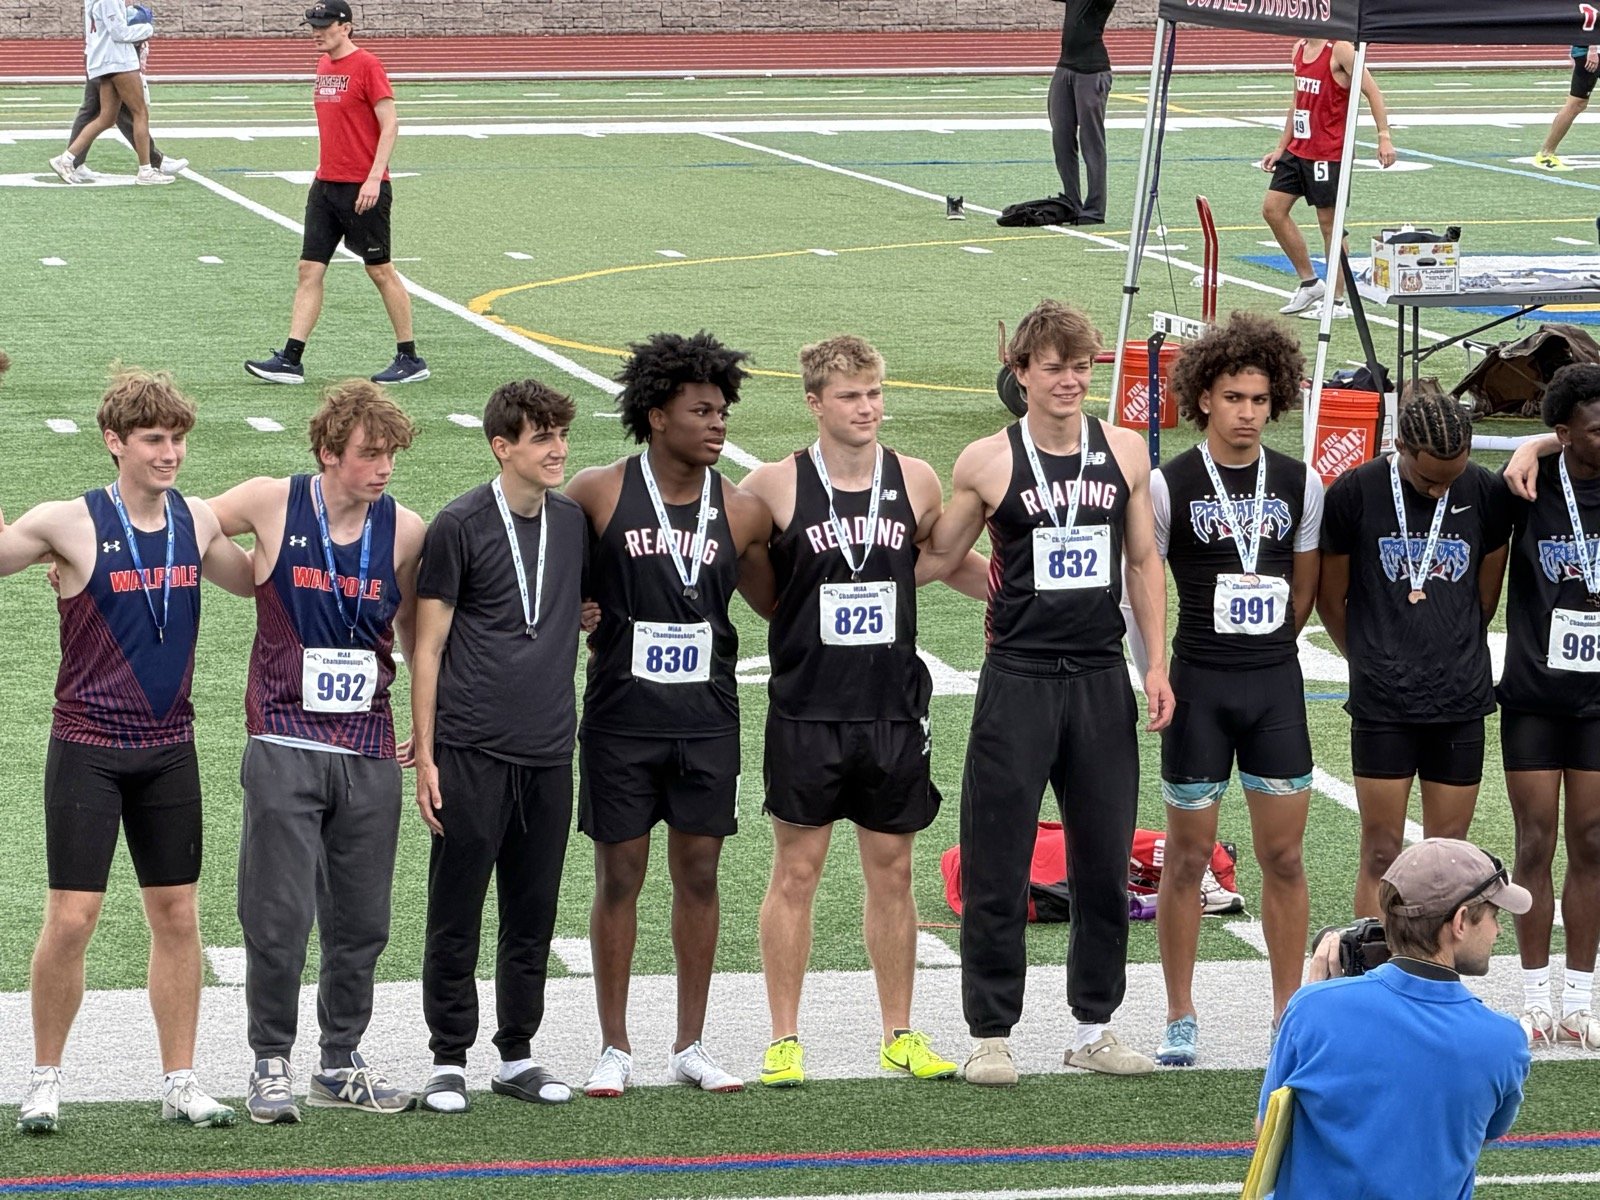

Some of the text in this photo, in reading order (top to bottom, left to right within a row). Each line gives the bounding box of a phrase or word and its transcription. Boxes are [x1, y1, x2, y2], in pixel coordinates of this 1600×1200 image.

[1296, 77, 1321, 94] ORTH
[1317, 162, 1326, 180] 5
[1530, 294, 1583, 302] FACILITIES
[1316, 428, 1365, 475] HOME
[1320, 431, 1341, 451] THE
[1332, 446, 1364, 477] DEPOT
[805, 516, 906, 554] READNG
[1190, 499, 1292, 543] PREDATRS
[1048, 548, 1098, 579] 832
[109, 565, 198, 593] WALPOLE
[292, 565, 382, 600] WALPOLE
[838, 591, 879, 600] Championships
[834, 605, 883, 635] 825
[1230, 596, 1275, 625] 991
[652, 631, 696, 639] Championships
[667, 625, 682, 633] MIAA
[646, 645, 699, 673] 830
[317, 672, 367, 702] 932
